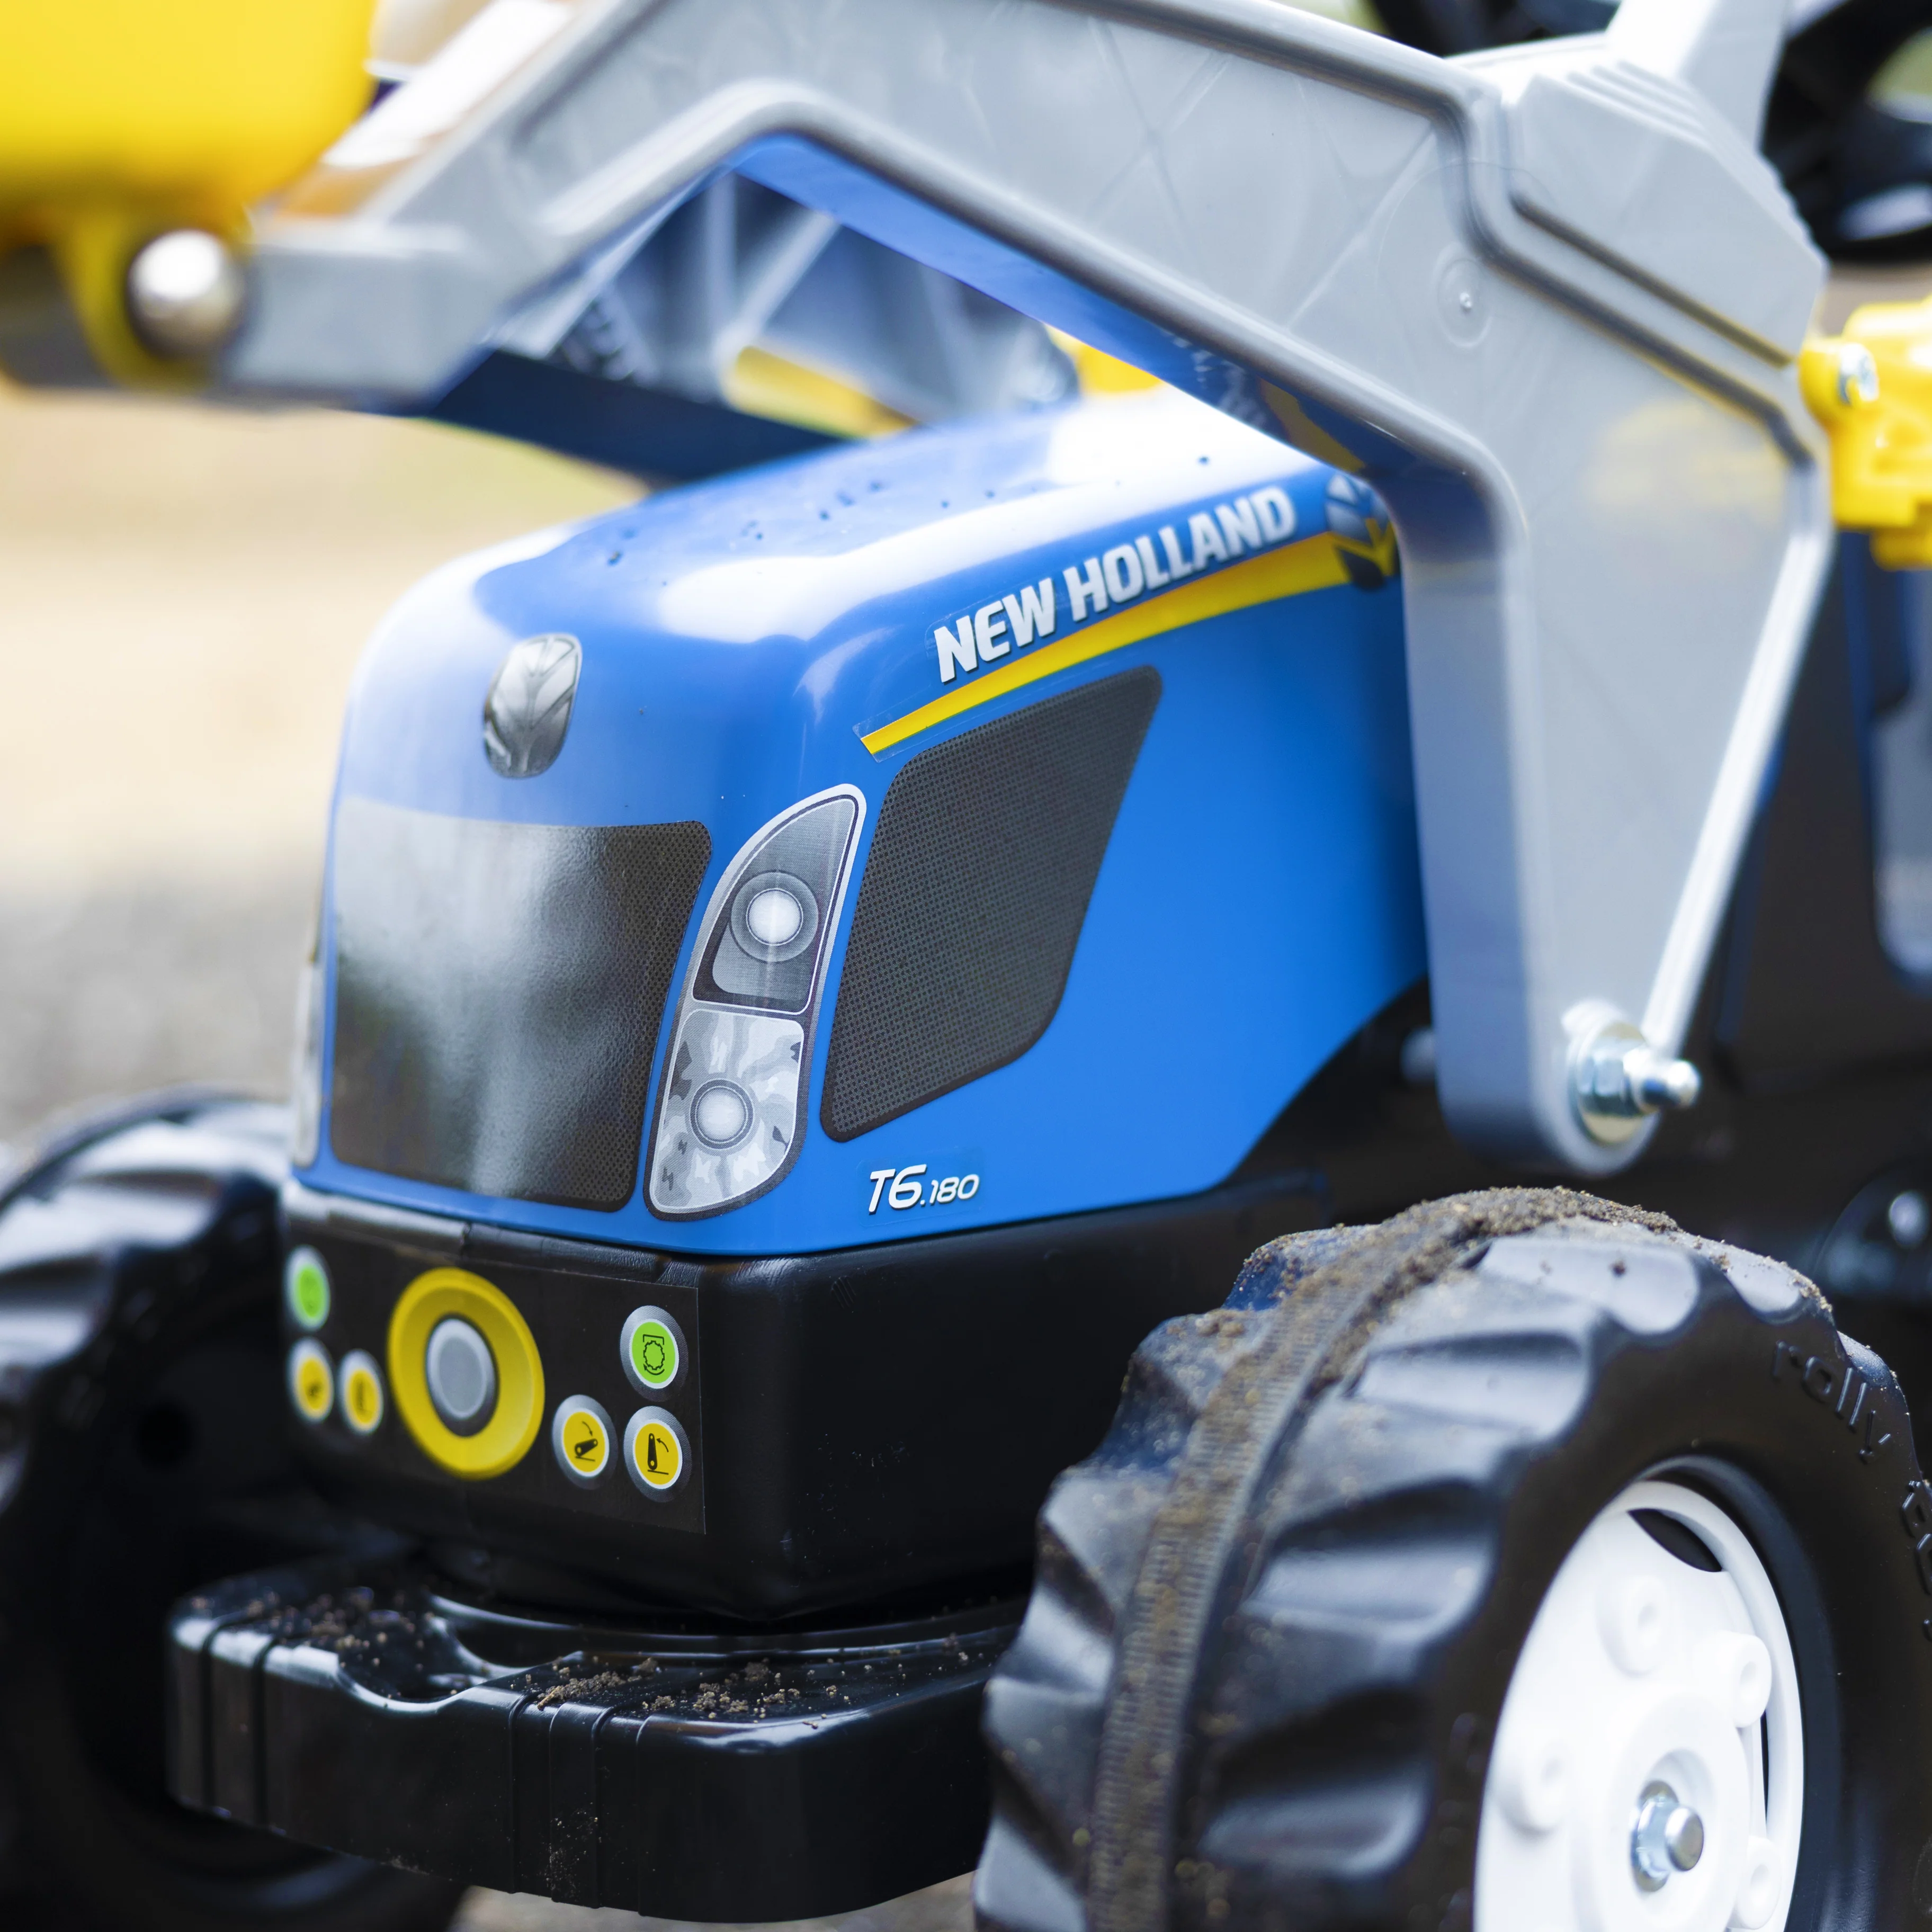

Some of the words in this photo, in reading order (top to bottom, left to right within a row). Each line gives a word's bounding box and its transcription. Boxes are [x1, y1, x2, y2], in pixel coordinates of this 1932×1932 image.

[934, 577, 1057, 683] NEW
[1063, 487, 1297, 623] HOLLAND
[869, 1164, 979, 1214] T6.180
